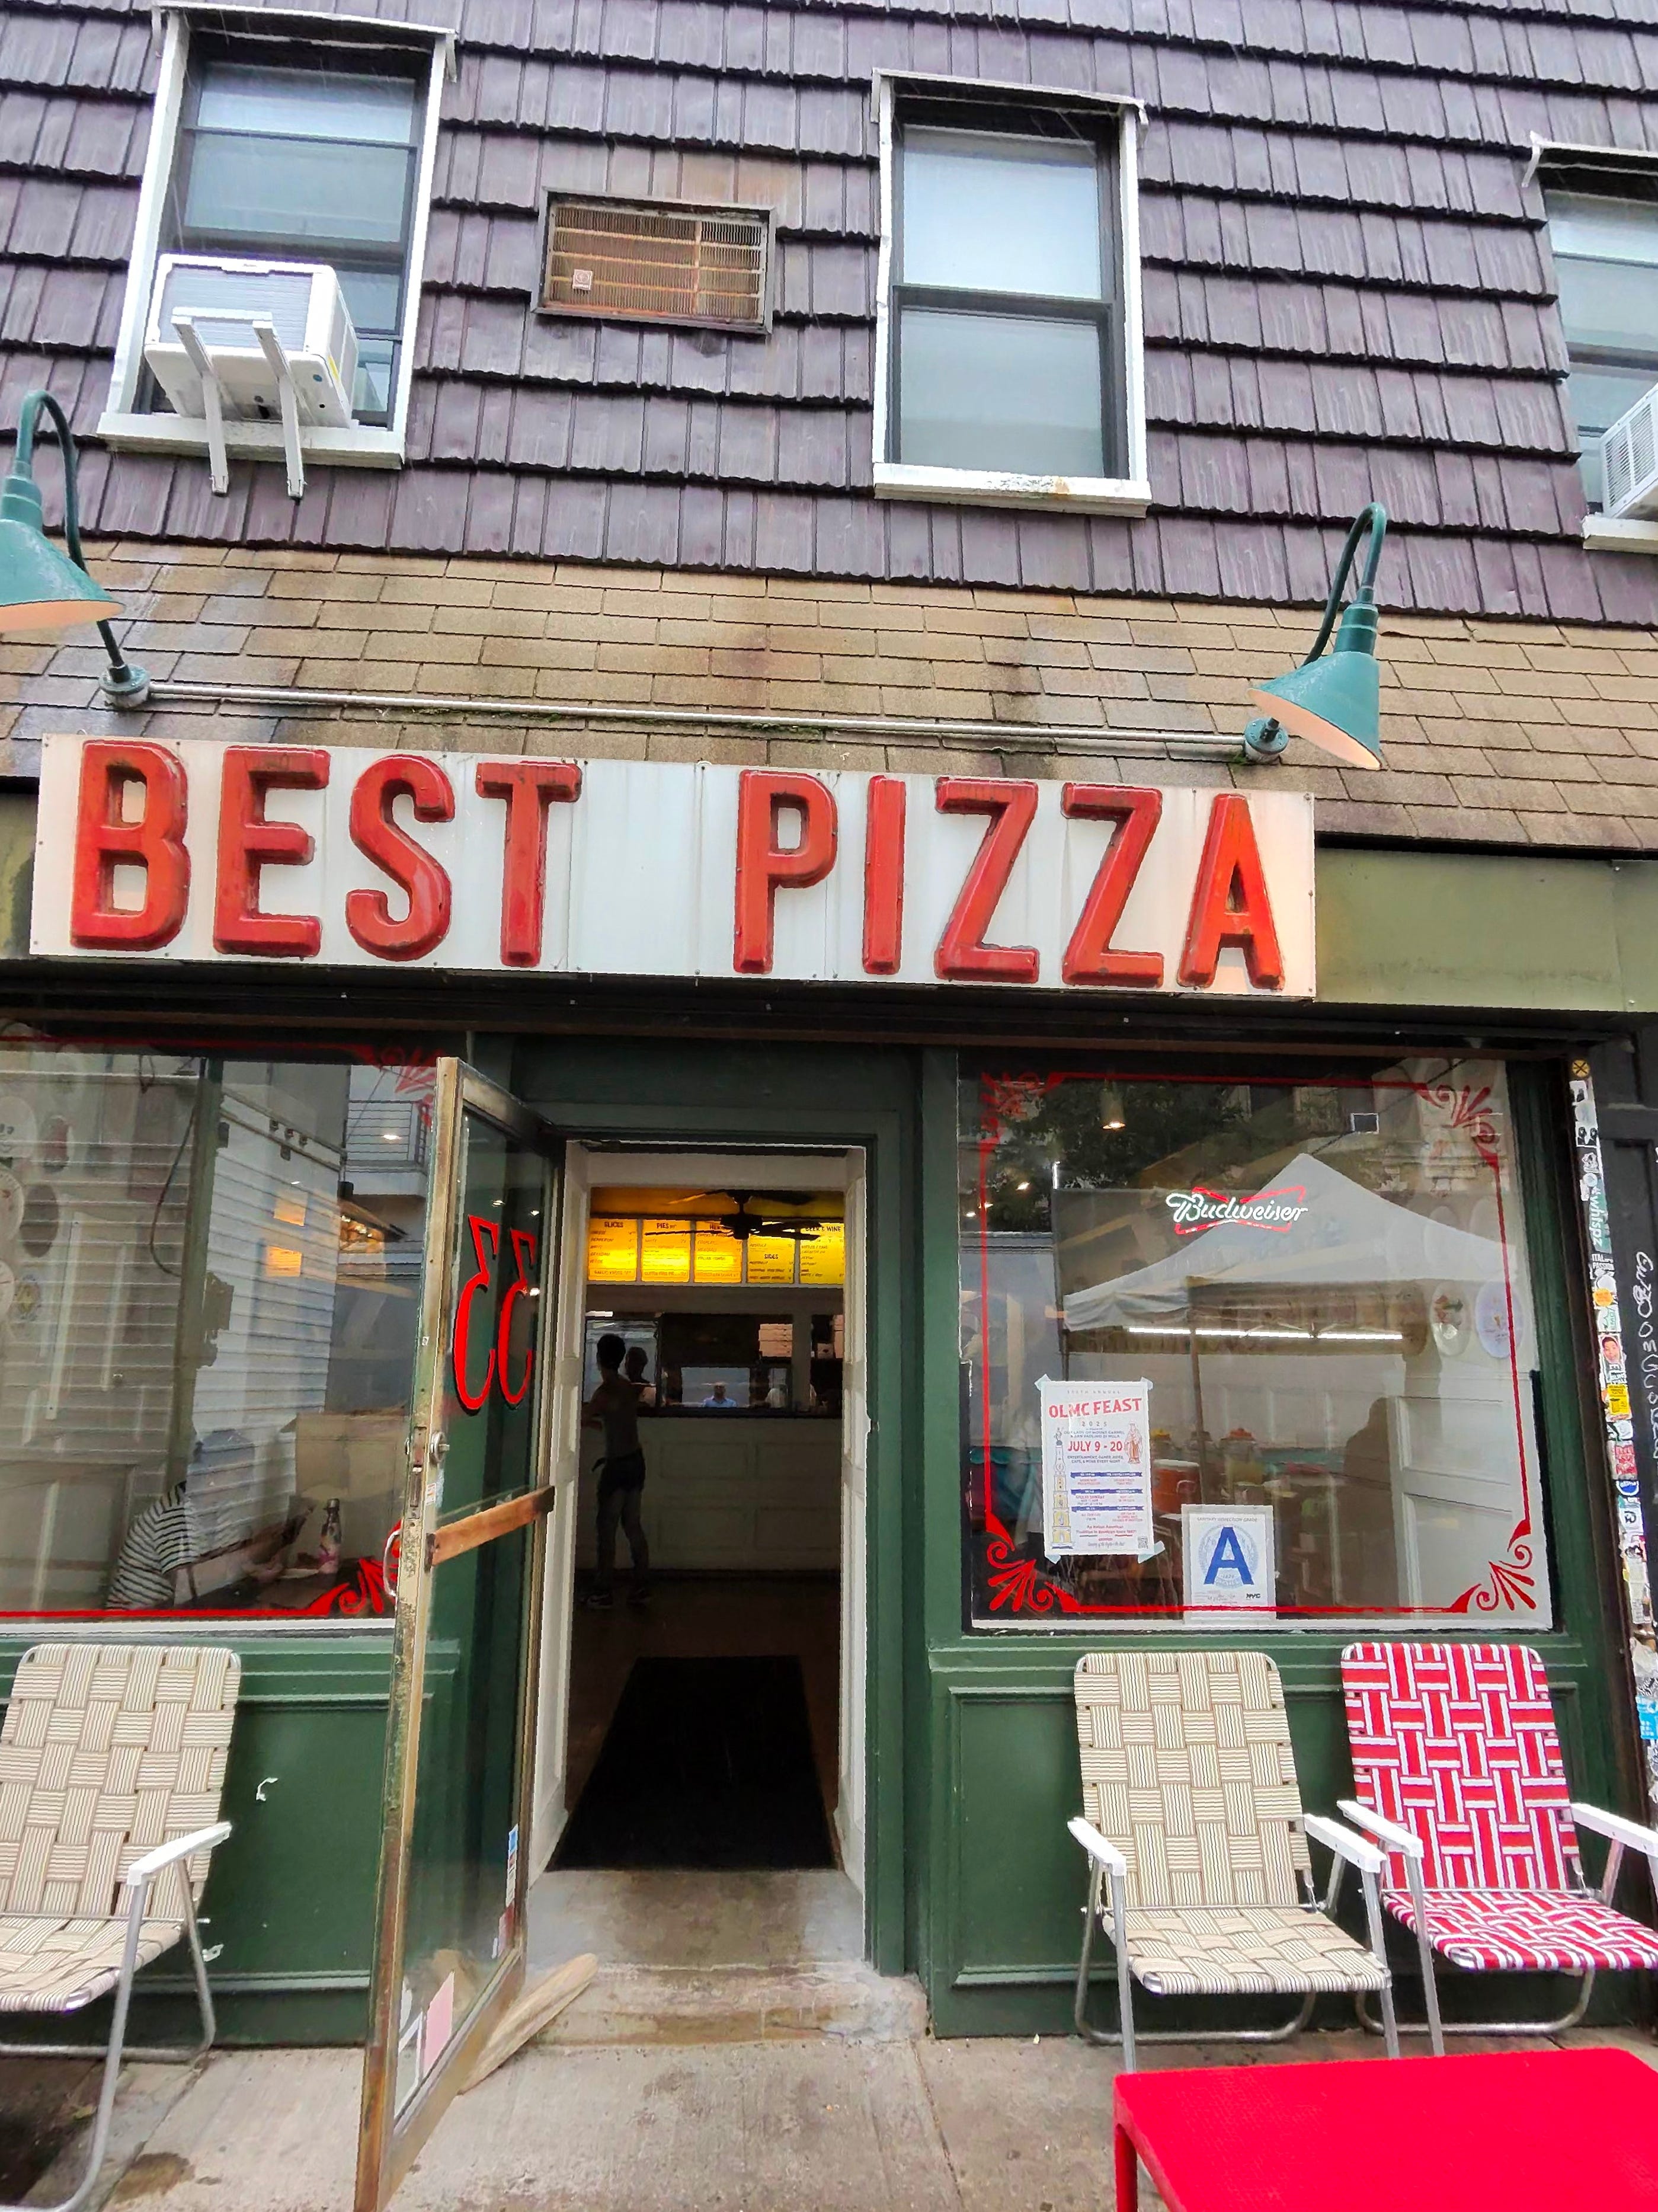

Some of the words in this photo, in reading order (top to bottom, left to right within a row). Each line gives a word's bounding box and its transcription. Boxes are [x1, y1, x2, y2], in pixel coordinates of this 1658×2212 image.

[71, 740, 581, 968] BEST
[733, 770, 1285, 991] PIZZA
[1166, 1193, 1308, 1222] Budweiser
[1049, 1402, 1090, 1418] OLMC
[1093, 1398, 1142, 1415] FEAST
[1068, 1441, 1092, 1452] JULY
[1094, 1441, 1100, 1452] 9
[1110, 1441, 1123, 1452] 20
[1204, 1527, 1254, 1584] A
